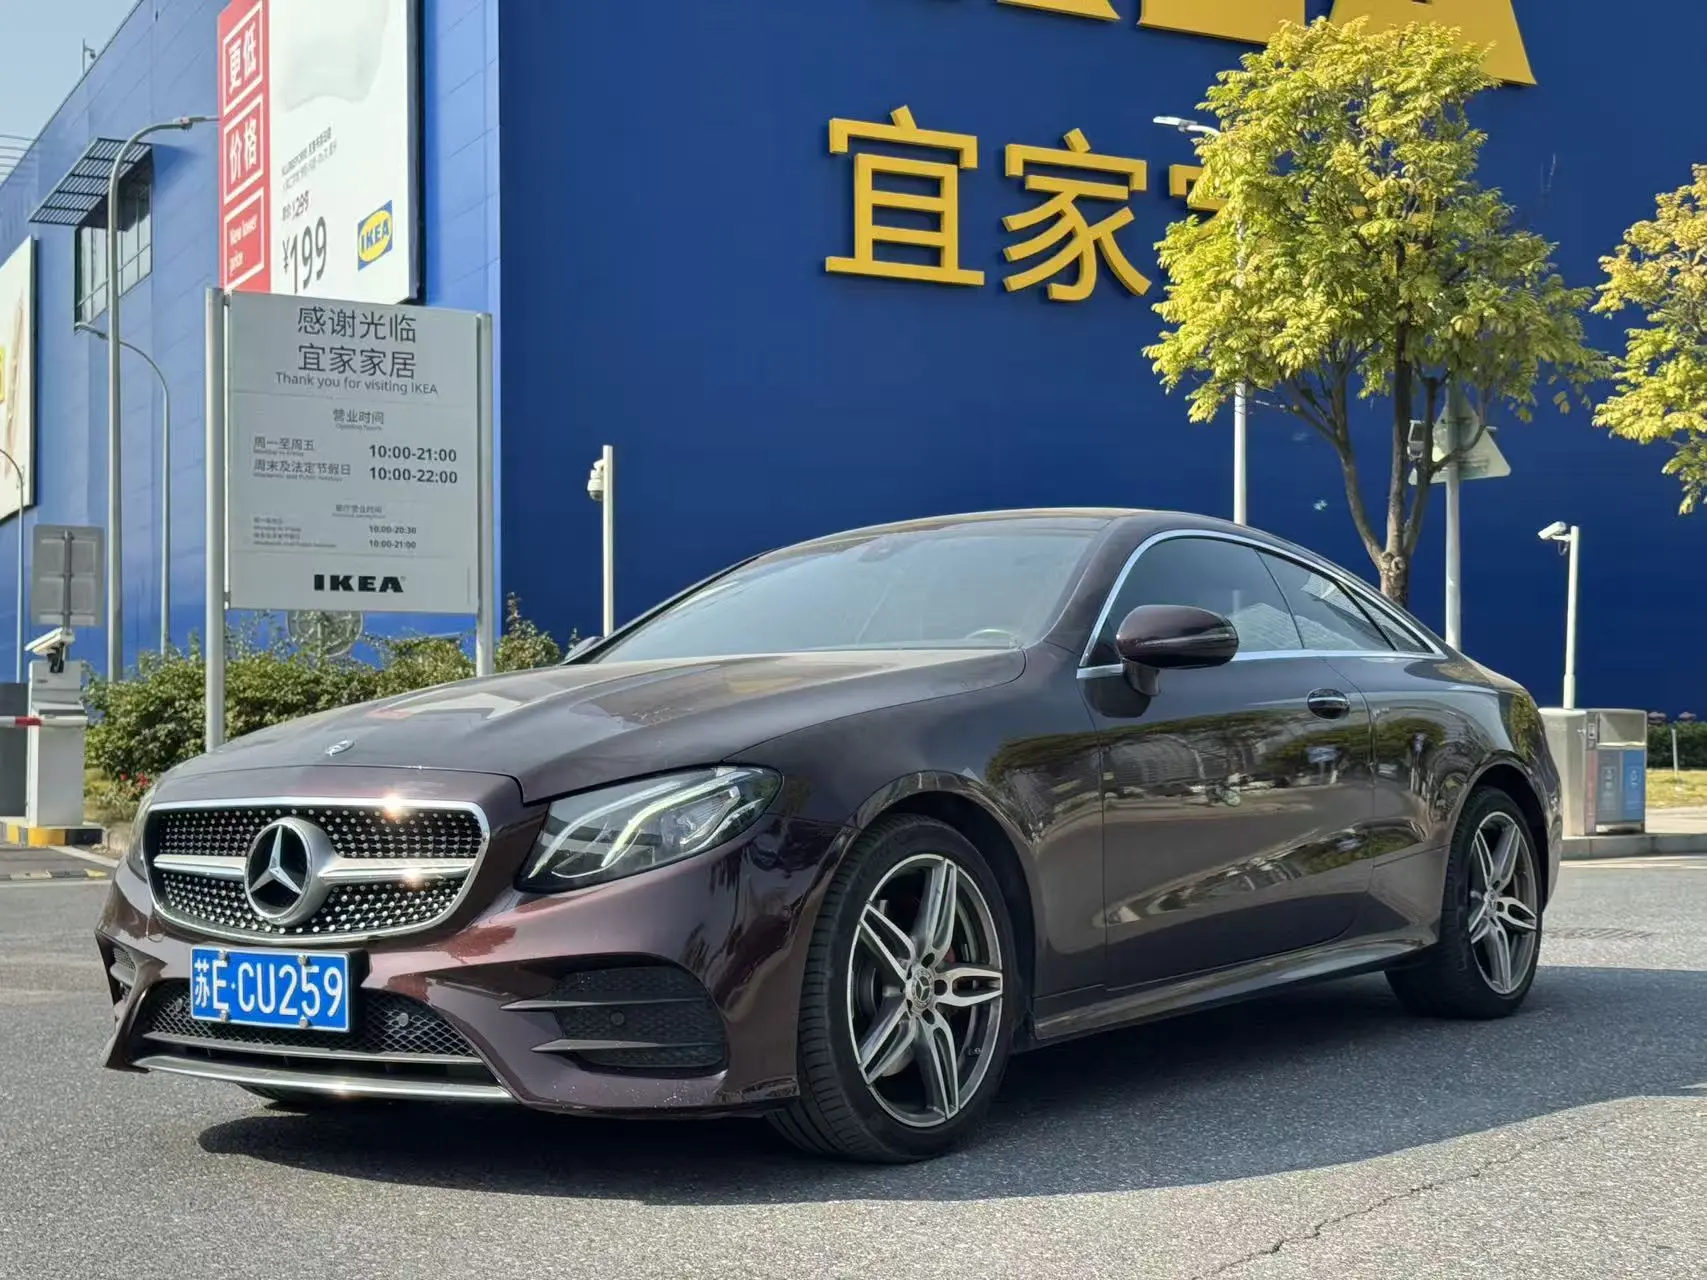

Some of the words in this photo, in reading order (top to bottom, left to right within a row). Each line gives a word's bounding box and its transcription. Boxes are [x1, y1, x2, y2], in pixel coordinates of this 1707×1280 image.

[228, 21, 257, 95] 更低
[229, 117, 258, 185] 价格
[360, 218, 390, 253] IKEA
[282, 216, 328, 294] ¥199
[297, 305, 417, 344] 感谢光临
[297, 343, 417, 379] 宜家家居
[275, 371, 316, 387] Thank
[317, 375, 341, 389] you
[343, 376, 361, 389] for
[364, 379, 408, 396] visiting
[411, 382, 438, 395] IKEA
[333, 408, 384, 425] 营业时间
[254, 436, 314, 451] 周一至周五
[369, 444, 458, 462] 10:00-21:00
[254, 459, 351, 475] 周末及法定节假日
[369, 466, 458, 484] 10:00-22:00
[314, 574, 404, 593] IKEA
